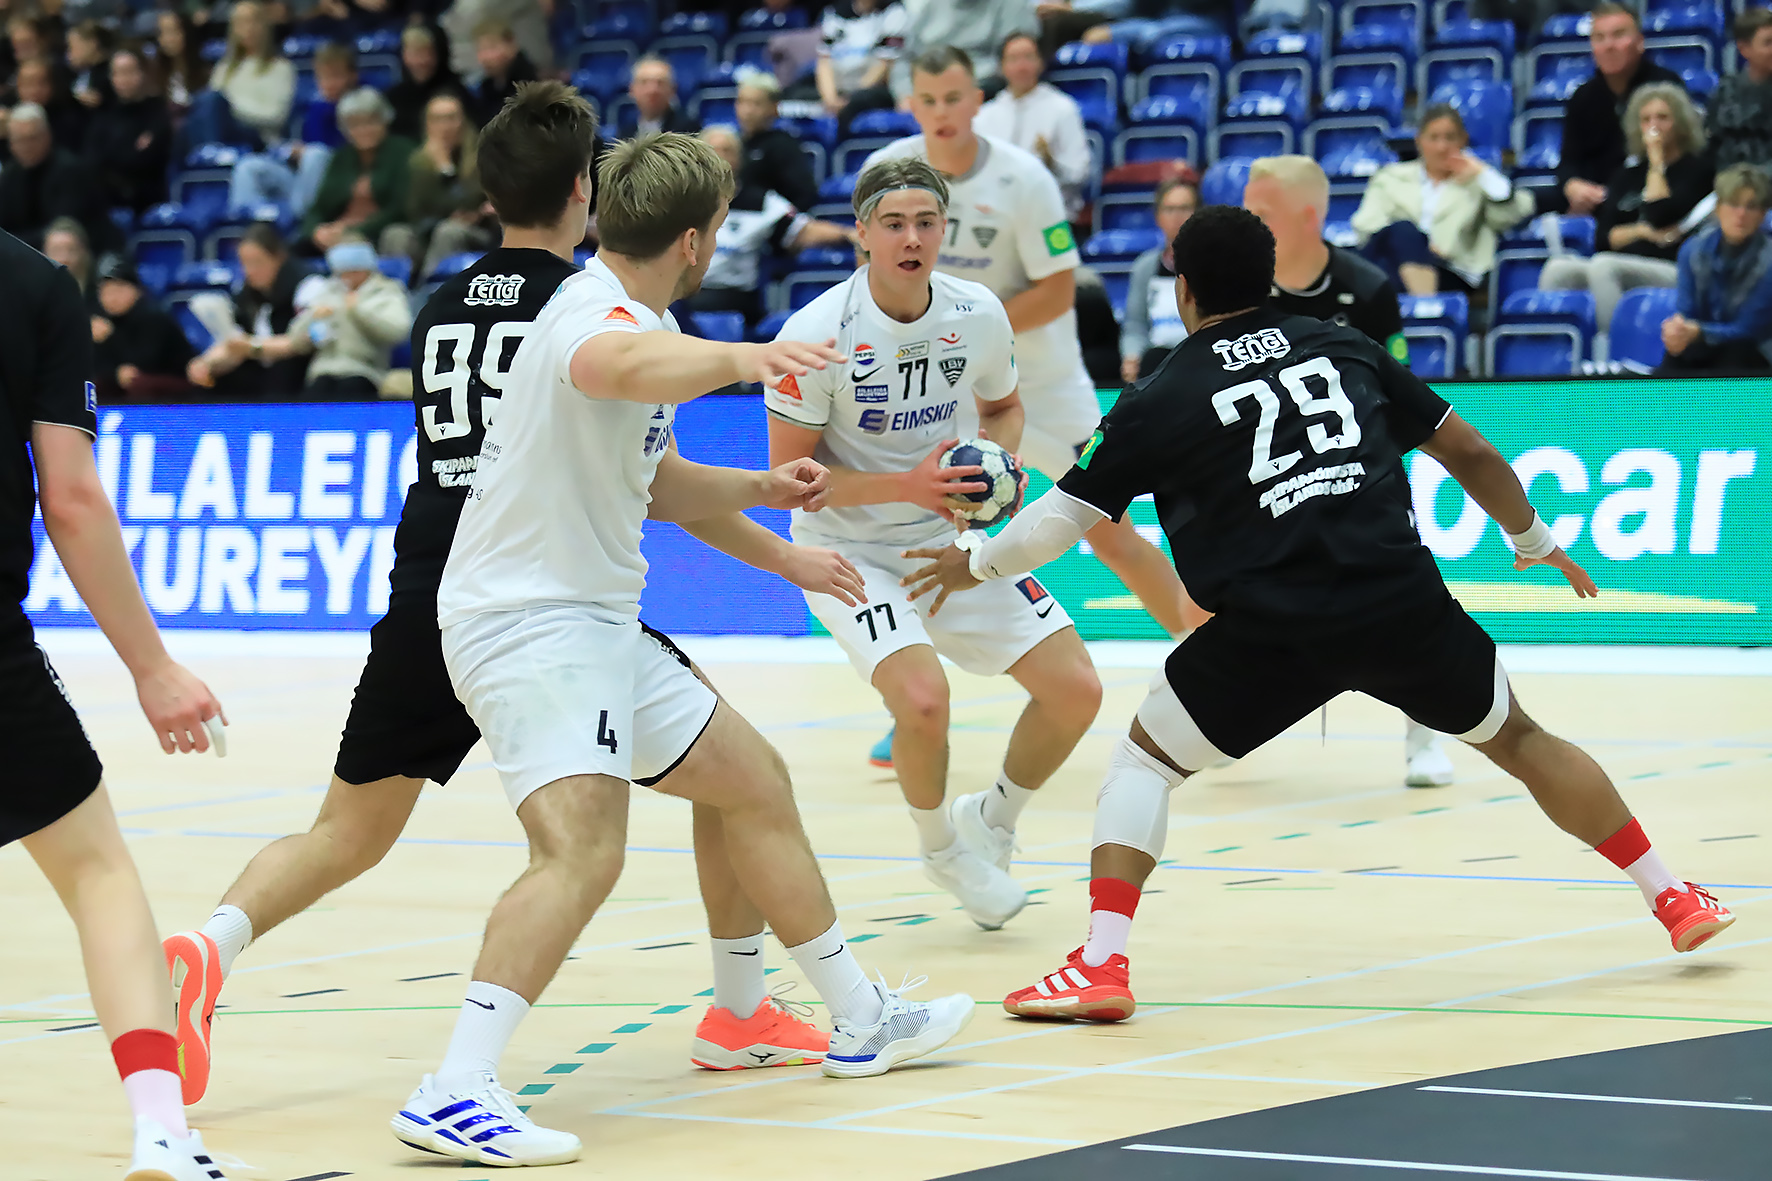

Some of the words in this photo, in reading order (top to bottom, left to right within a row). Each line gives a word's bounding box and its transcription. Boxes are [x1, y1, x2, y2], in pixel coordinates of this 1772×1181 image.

[855, 351, 875, 359] PEPSI
[898, 357, 929, 400] 77
[891, 400, 958, 431] EIMSKIP
[1212, 356, 1362, 485] 29
[21, 525, 397, 615] AUREY
[855, 602, 897, 642] 77
[596, 710, 618, 755] 4
